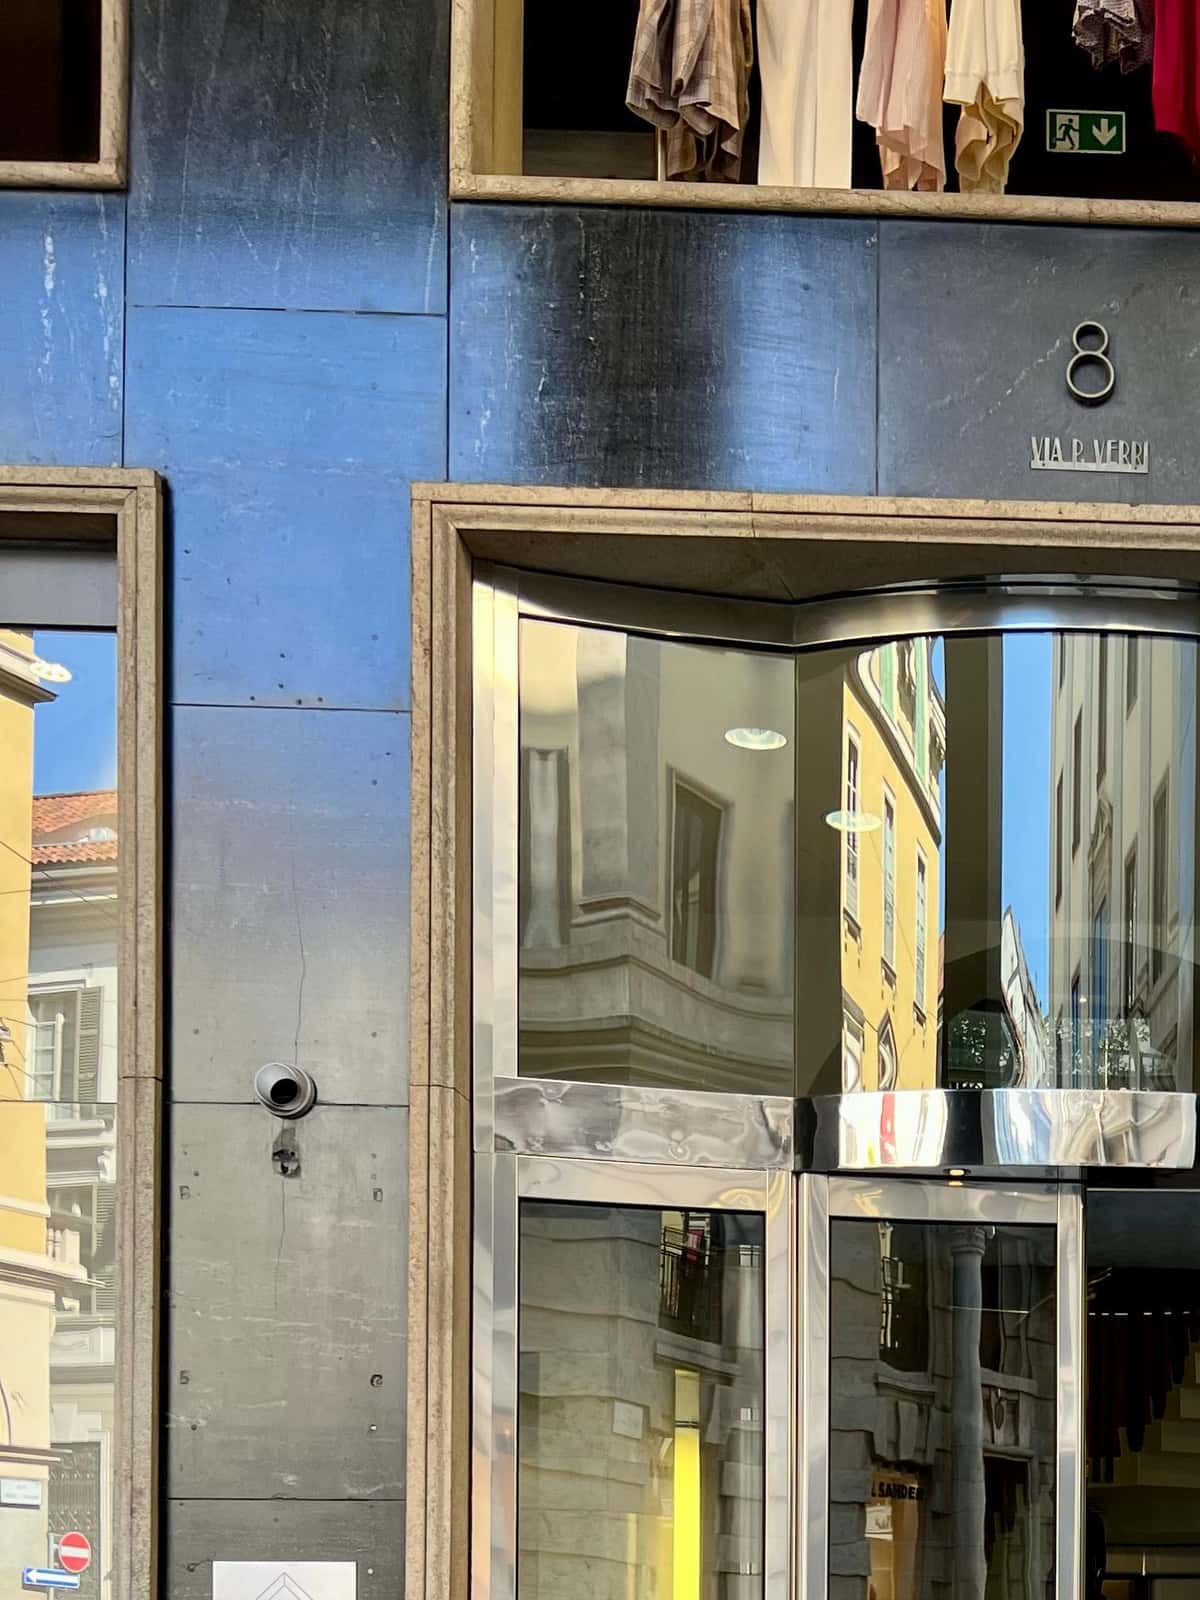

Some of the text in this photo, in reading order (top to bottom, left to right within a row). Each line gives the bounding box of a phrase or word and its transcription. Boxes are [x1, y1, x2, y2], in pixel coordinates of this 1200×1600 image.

[1066, 320, 1115, 399] 8
[1031, 436, 1149, 470] VIA P. VERRI
